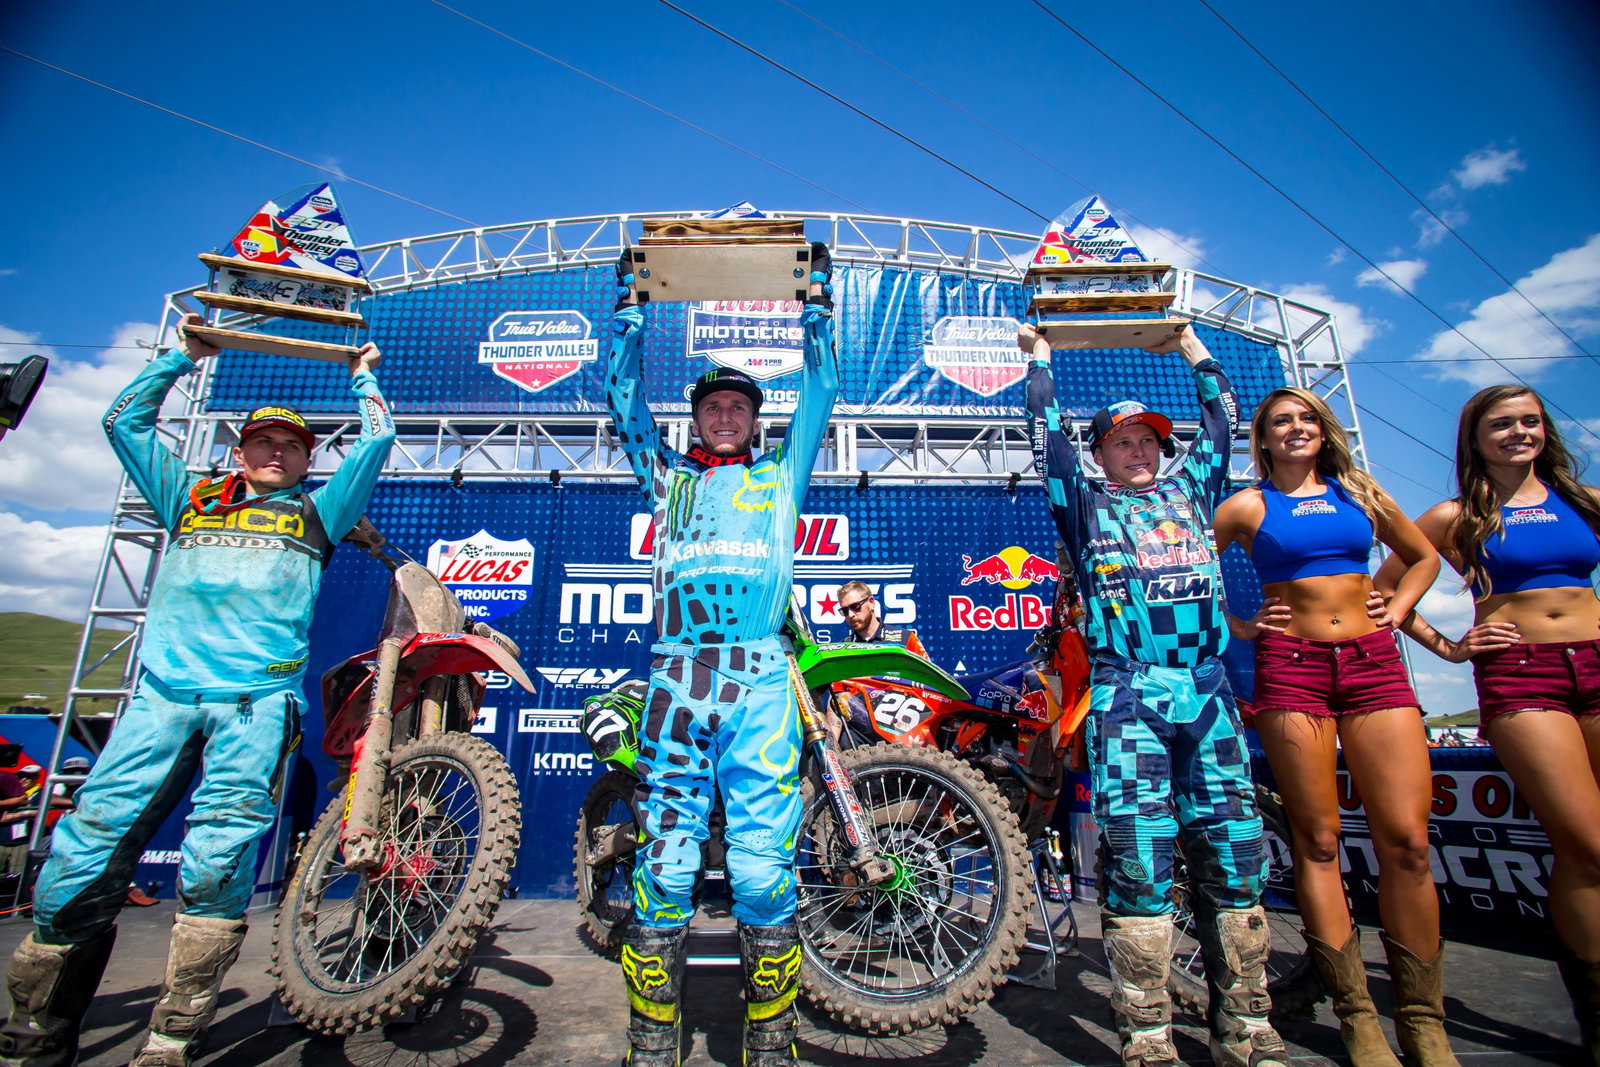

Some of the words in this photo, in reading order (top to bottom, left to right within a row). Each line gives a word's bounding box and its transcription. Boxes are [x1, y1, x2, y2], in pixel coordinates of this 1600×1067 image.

[283, 214, 340, 231] 250
[280, 227, 348, 247] Thunder
[1070, 239, 1127, 248] Thunder
[287, 239, 337, 260] Valley
[1079, 247, 1121, 258] Valley
[483, 345, 543, 358] THUNDER
[545, 343, 595, 357] VALLEY
[927, 350, 987, 363] THUNDER
[952, 368, 1017, 376] NATIONAL
[252, 407, 306, 428] GEICO
[1032, 416, 1048, 451] bakery
[686, 447, 748, 468] SCOTT
[180, 507, 304, 538] GEICO
[668, 539, 769, 564] Kawasak
[1137, 545, 1176, 568] Red
[440, 559, 530, 583] LUCAS
[677, 567, 706, 580] PRO
[708, 566, 765, 576] CIRCUIT
[455, 589, 528, 601] PRODUCTS
[1146, 572, 1212, 602] KTM
[464, 605, 491, 617] INC.
[951, 596, 1015, 631] Red
[546, 667, 632, 684] FLY
[979, 688, 1012, 703] GoPro
[874, 693, 926, 733] 26
[534, 753, 593, 770] KMC
[343, 771, 357, 821] GEICO
[1075, 783, 1092, 802] Re
